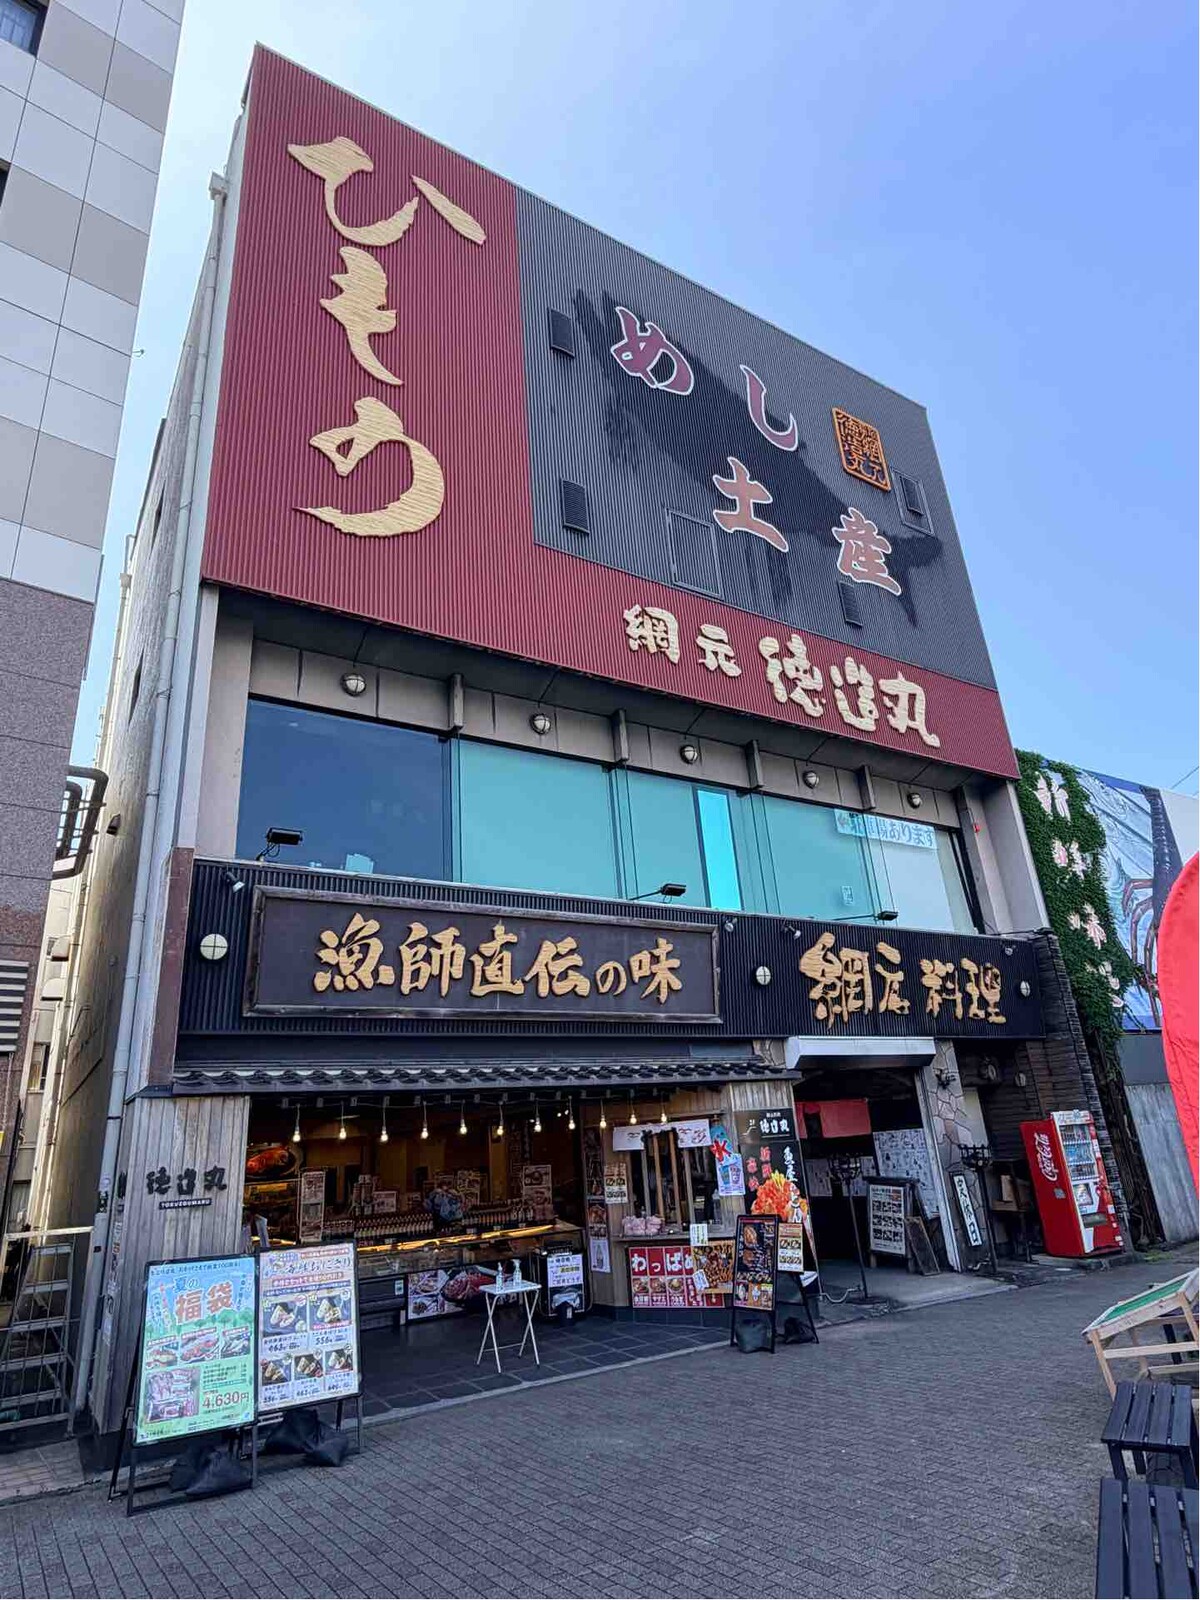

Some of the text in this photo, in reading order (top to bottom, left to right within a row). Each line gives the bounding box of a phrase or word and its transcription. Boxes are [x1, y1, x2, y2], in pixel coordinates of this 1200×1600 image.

[610, 307, 798, 451] めし
[713, 457, 901, 596] 土産
[313, 912, 683, 1004] 漁師直伝の味
[709, 1139, 732, 1164] 氷
[161, 1200, 211, 1209] TOKUZOUMARU
[174, 1276, 199, 1293] 夏の
[175, 1281, 232, 1325] 福袋
[203, 1391, 249, 1409] 4,630円
